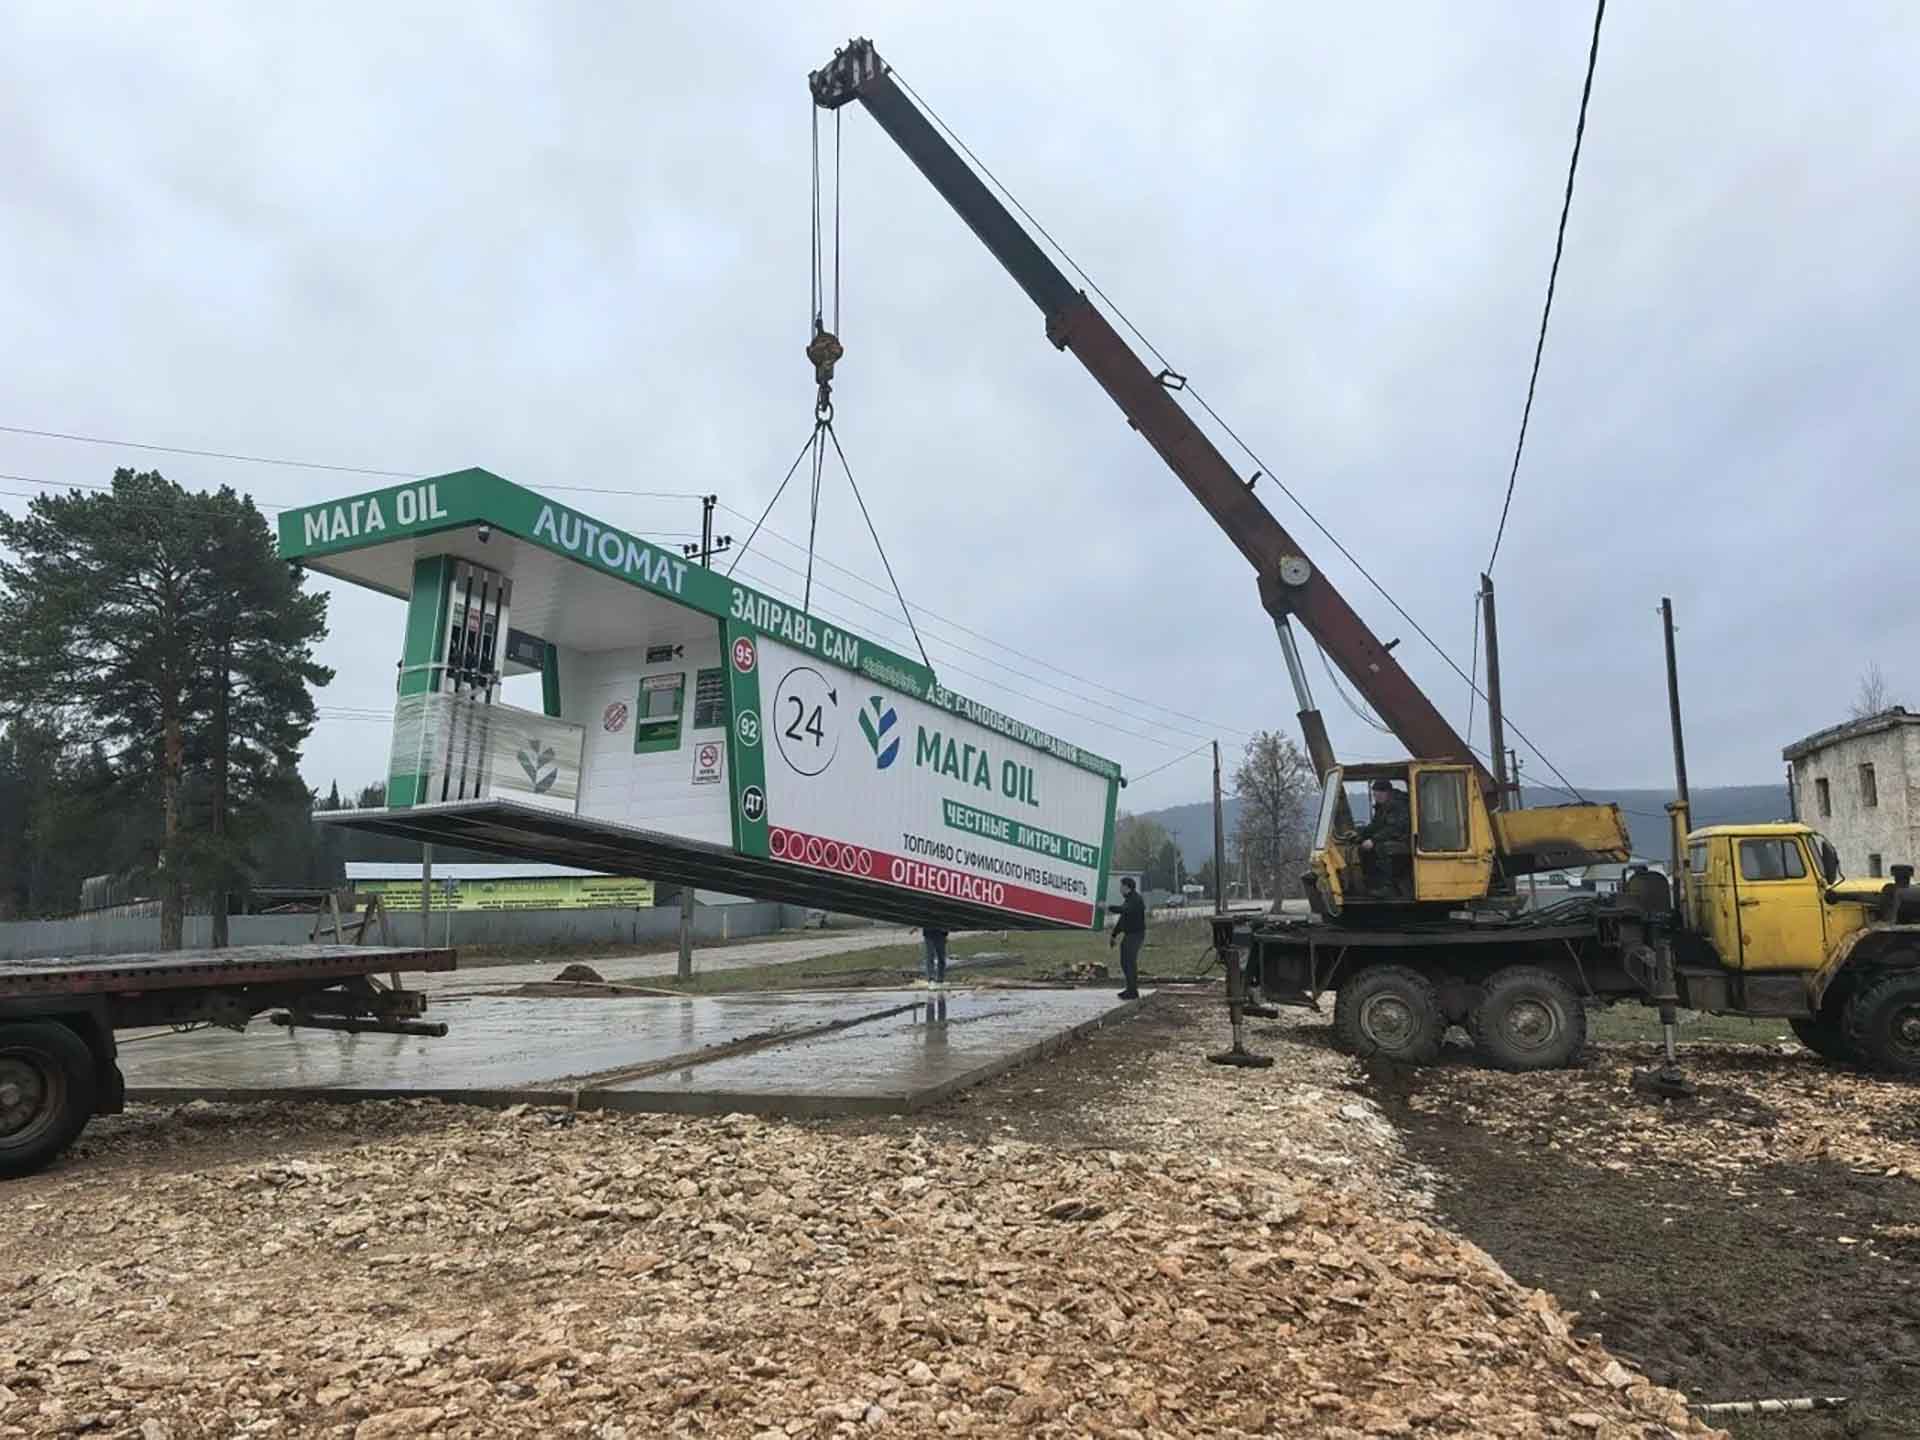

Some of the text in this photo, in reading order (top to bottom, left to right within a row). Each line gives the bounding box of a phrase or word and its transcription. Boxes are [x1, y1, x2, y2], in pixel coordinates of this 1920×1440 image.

[303, 483, 447, 546] МАГА OIL
[533, 504, 688, 594] AUTOMAT
[730, 588, 859, 668] ЗАПРАВЬ САМ
[735, 645, 753, 663] 95
[740, 718, 757, 738] 92
[785, 695, 824, 747] 24
[926, 683, 1079, 763] АЗС САМООБСЛУЖИВАНИЯ
[916, 725, 992, 791] МАГА
[1001, 759, 1040, 808] OIL
[745, 792, 762, 812] ДТ
[903, 833, 1088, 896] ТОПЛИВО С УФИМСКОГО НПЗ БАШНЕФТЬ
[946, 803, 1094, 864] ЧЕСТНЫЕ ЛИТРЫ ГОСТ
[891, 859, 1005, 905] ОГНЕОПАСНО
